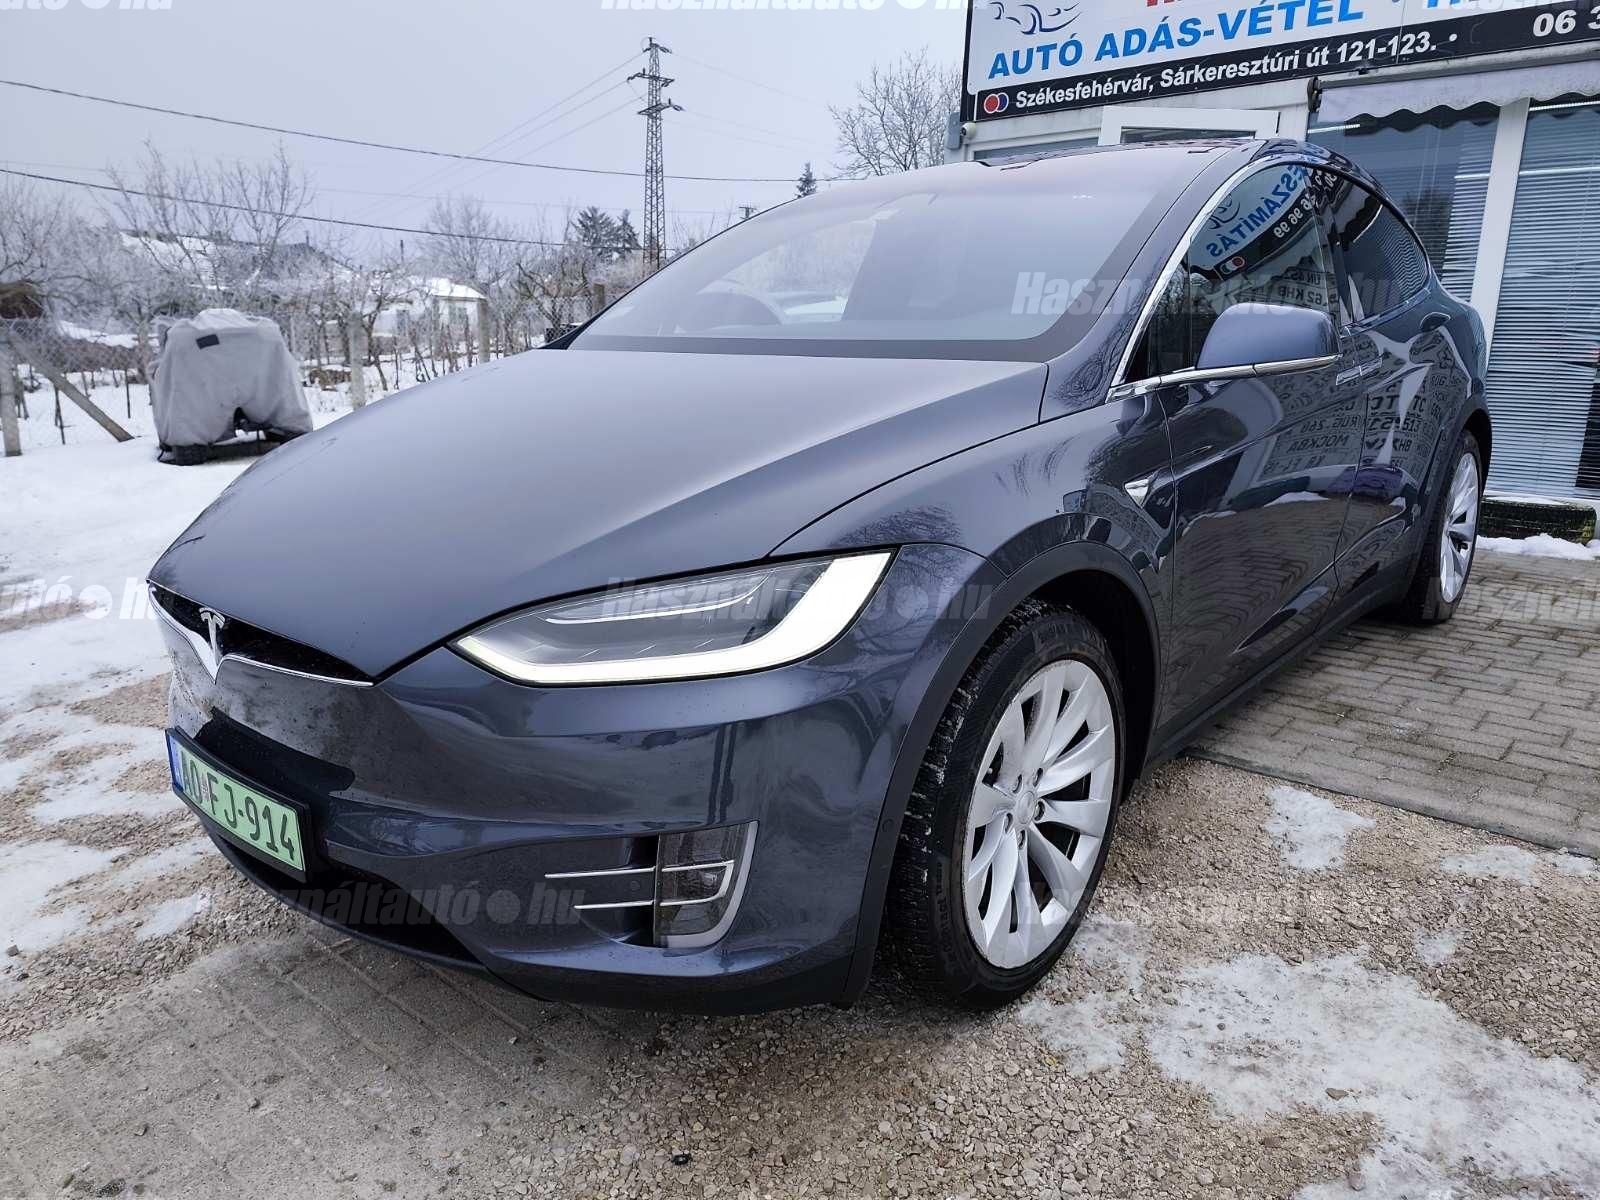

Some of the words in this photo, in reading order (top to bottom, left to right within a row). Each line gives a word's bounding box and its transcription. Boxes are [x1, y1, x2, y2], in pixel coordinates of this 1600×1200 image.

[988, 33, 1082, 79] AUTÓ
[1094, 0, 1365, 62] ADÁS-VÉTEL
[1015, 74, 1154, 108] Székesfehérvár,
[1160, 49, 1299, 88] Sárkeresztúri
[1306, 48, 1330, 67] út
[1337, 31, 1437, 63] 121-123.
[1533, 9, 1577, 37] 06
[207, 771, 296, 861] FJ-914
